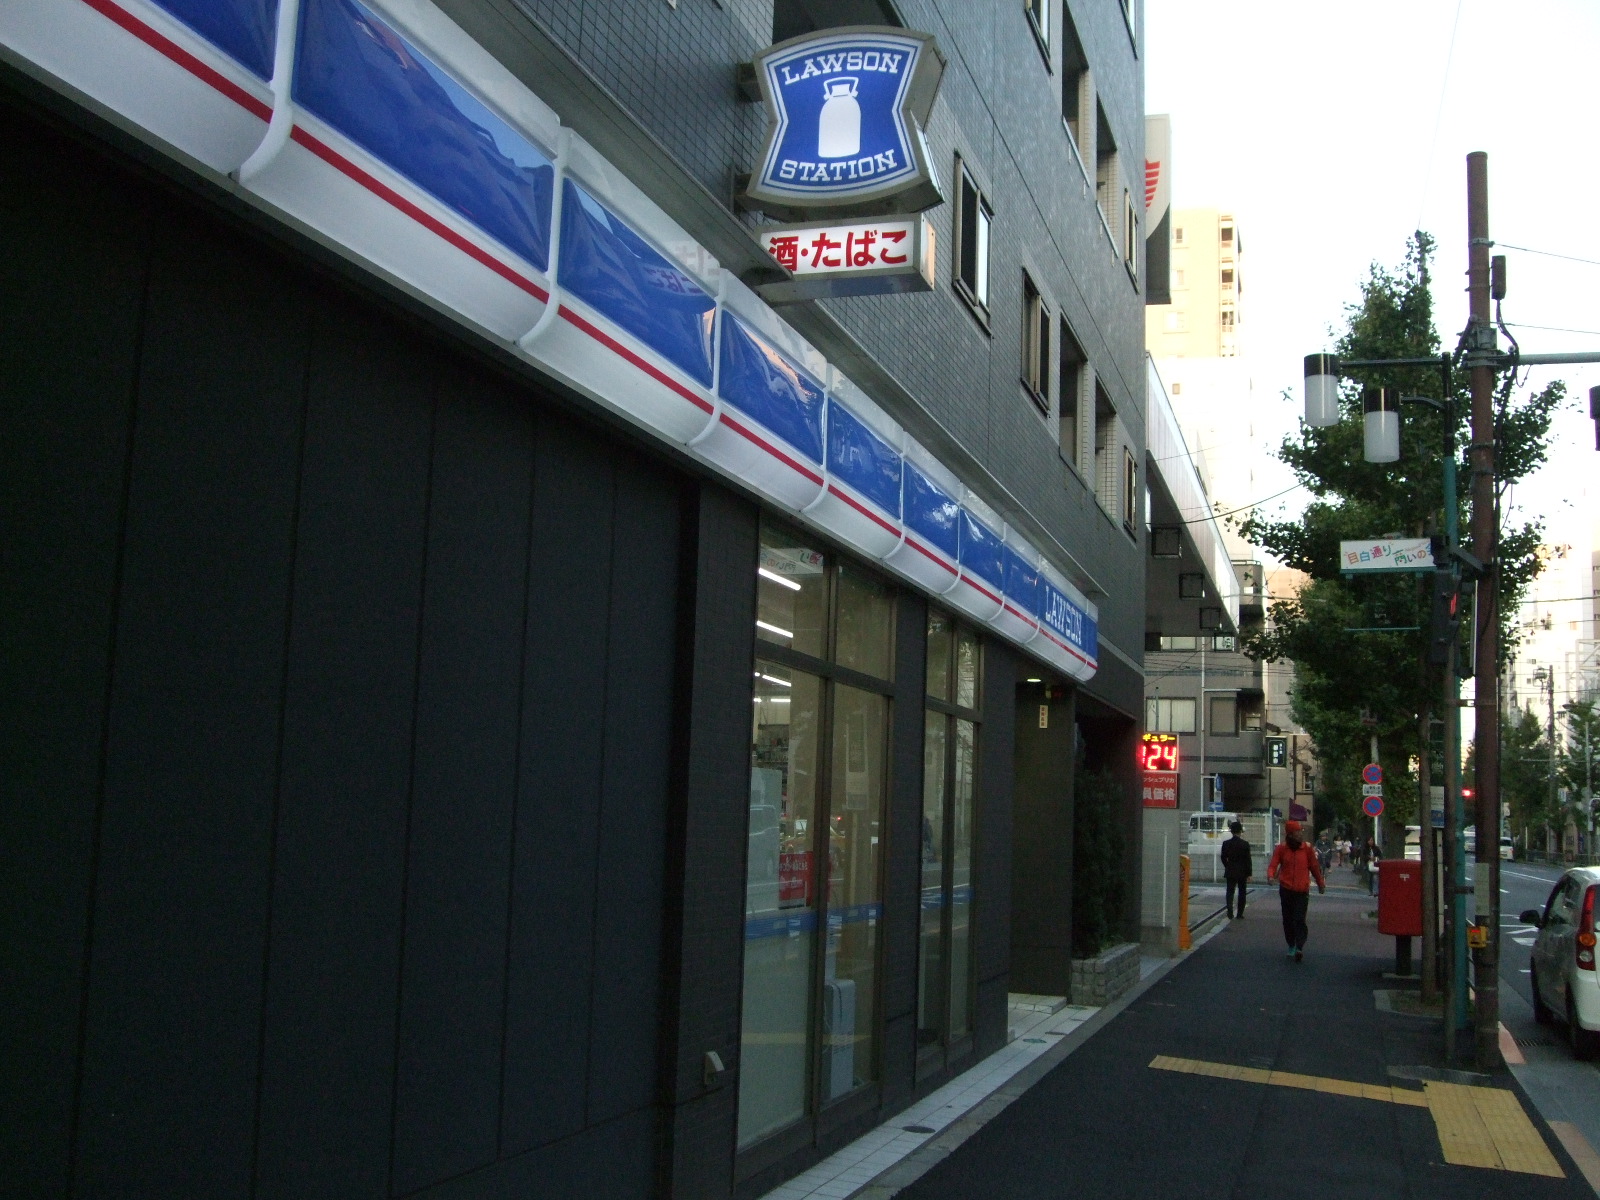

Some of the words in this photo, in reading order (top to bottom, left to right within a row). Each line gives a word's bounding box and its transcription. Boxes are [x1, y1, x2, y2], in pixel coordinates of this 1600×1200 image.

[781, 51, 901, 85] LAWSON
[779, 148, 898, 182] STATION
[1045, 585, 1082, 646] LAWSON
